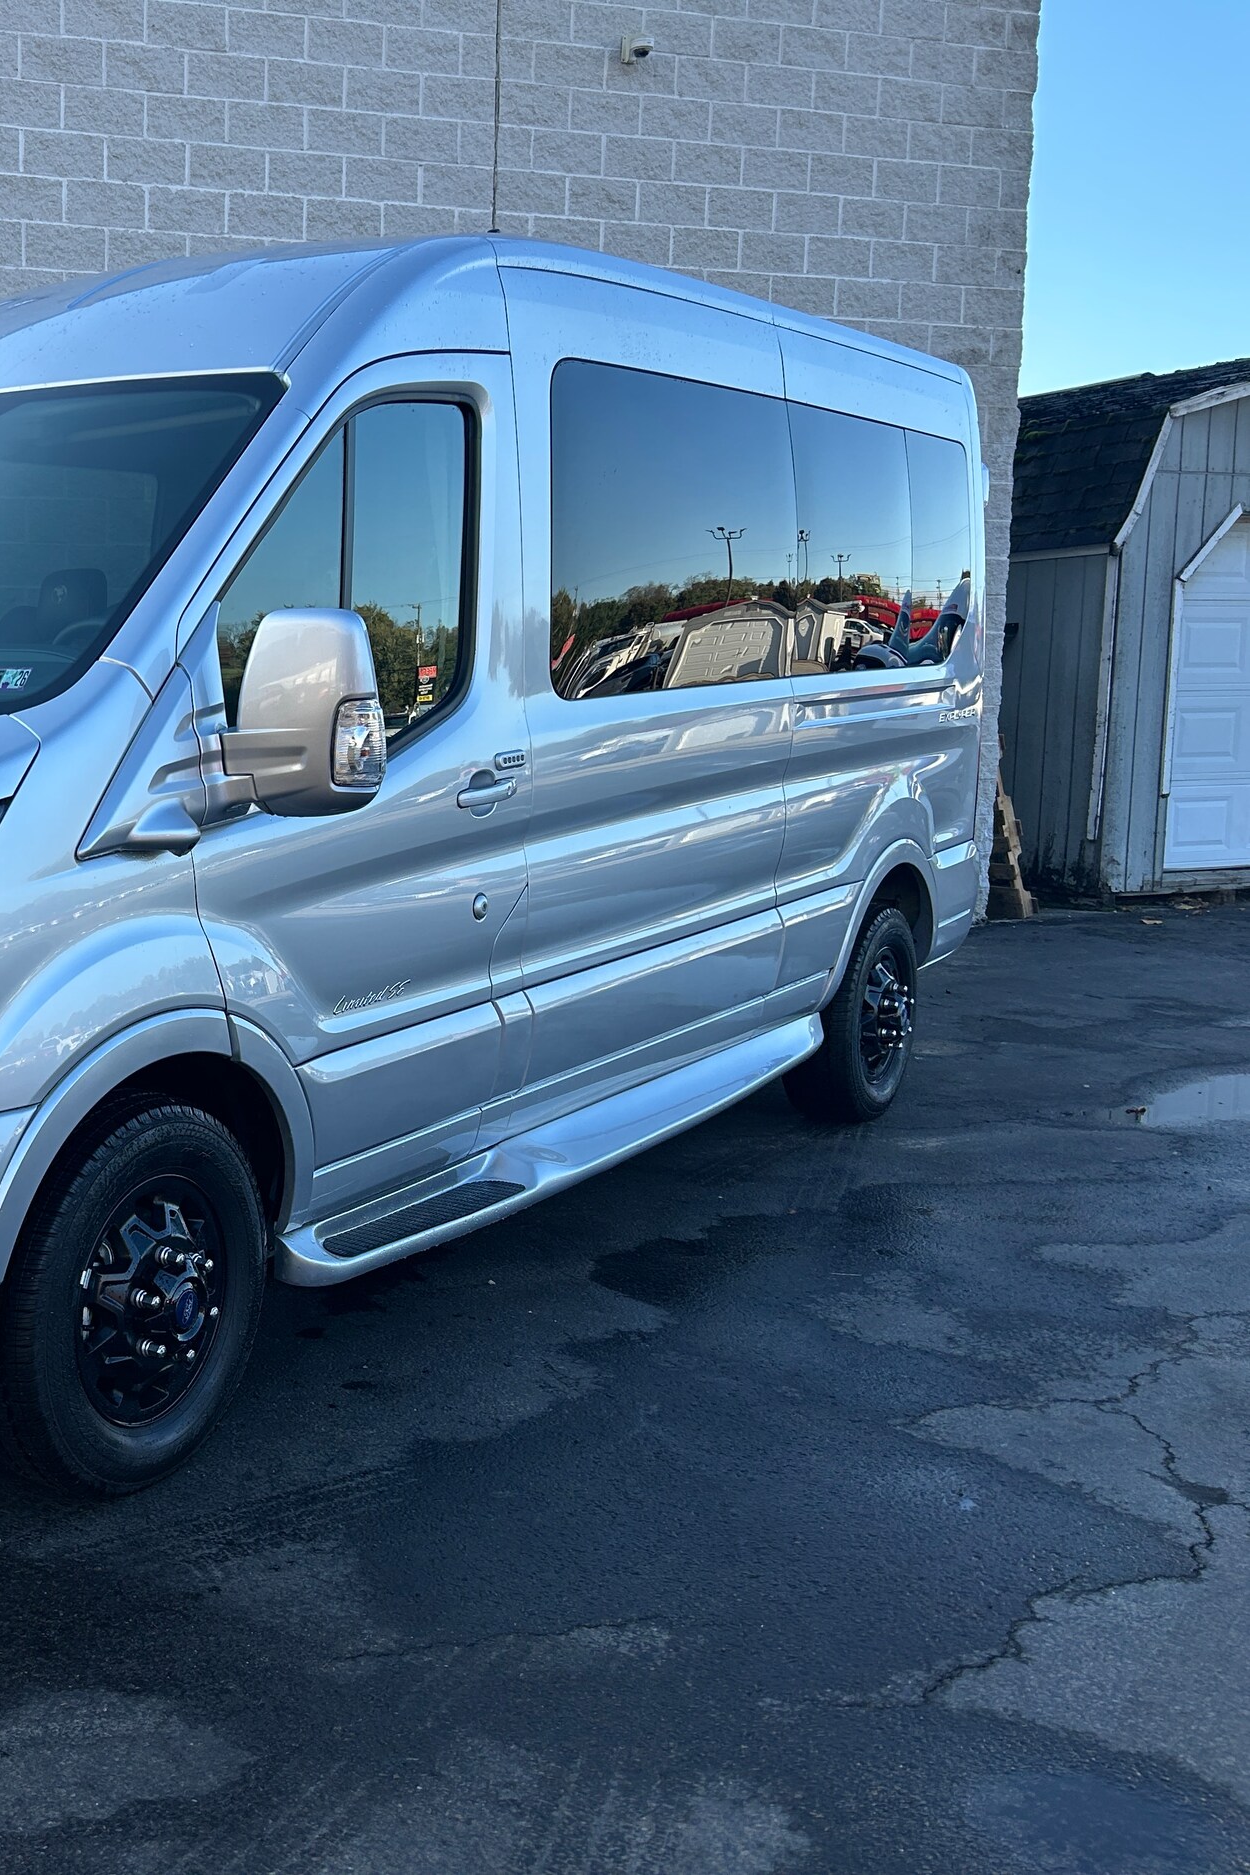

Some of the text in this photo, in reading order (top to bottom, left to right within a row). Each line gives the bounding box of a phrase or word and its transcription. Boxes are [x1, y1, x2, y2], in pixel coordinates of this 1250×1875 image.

[14, 670, 30, 687] 26
[333, 979, 411, 1015] Limited SE
